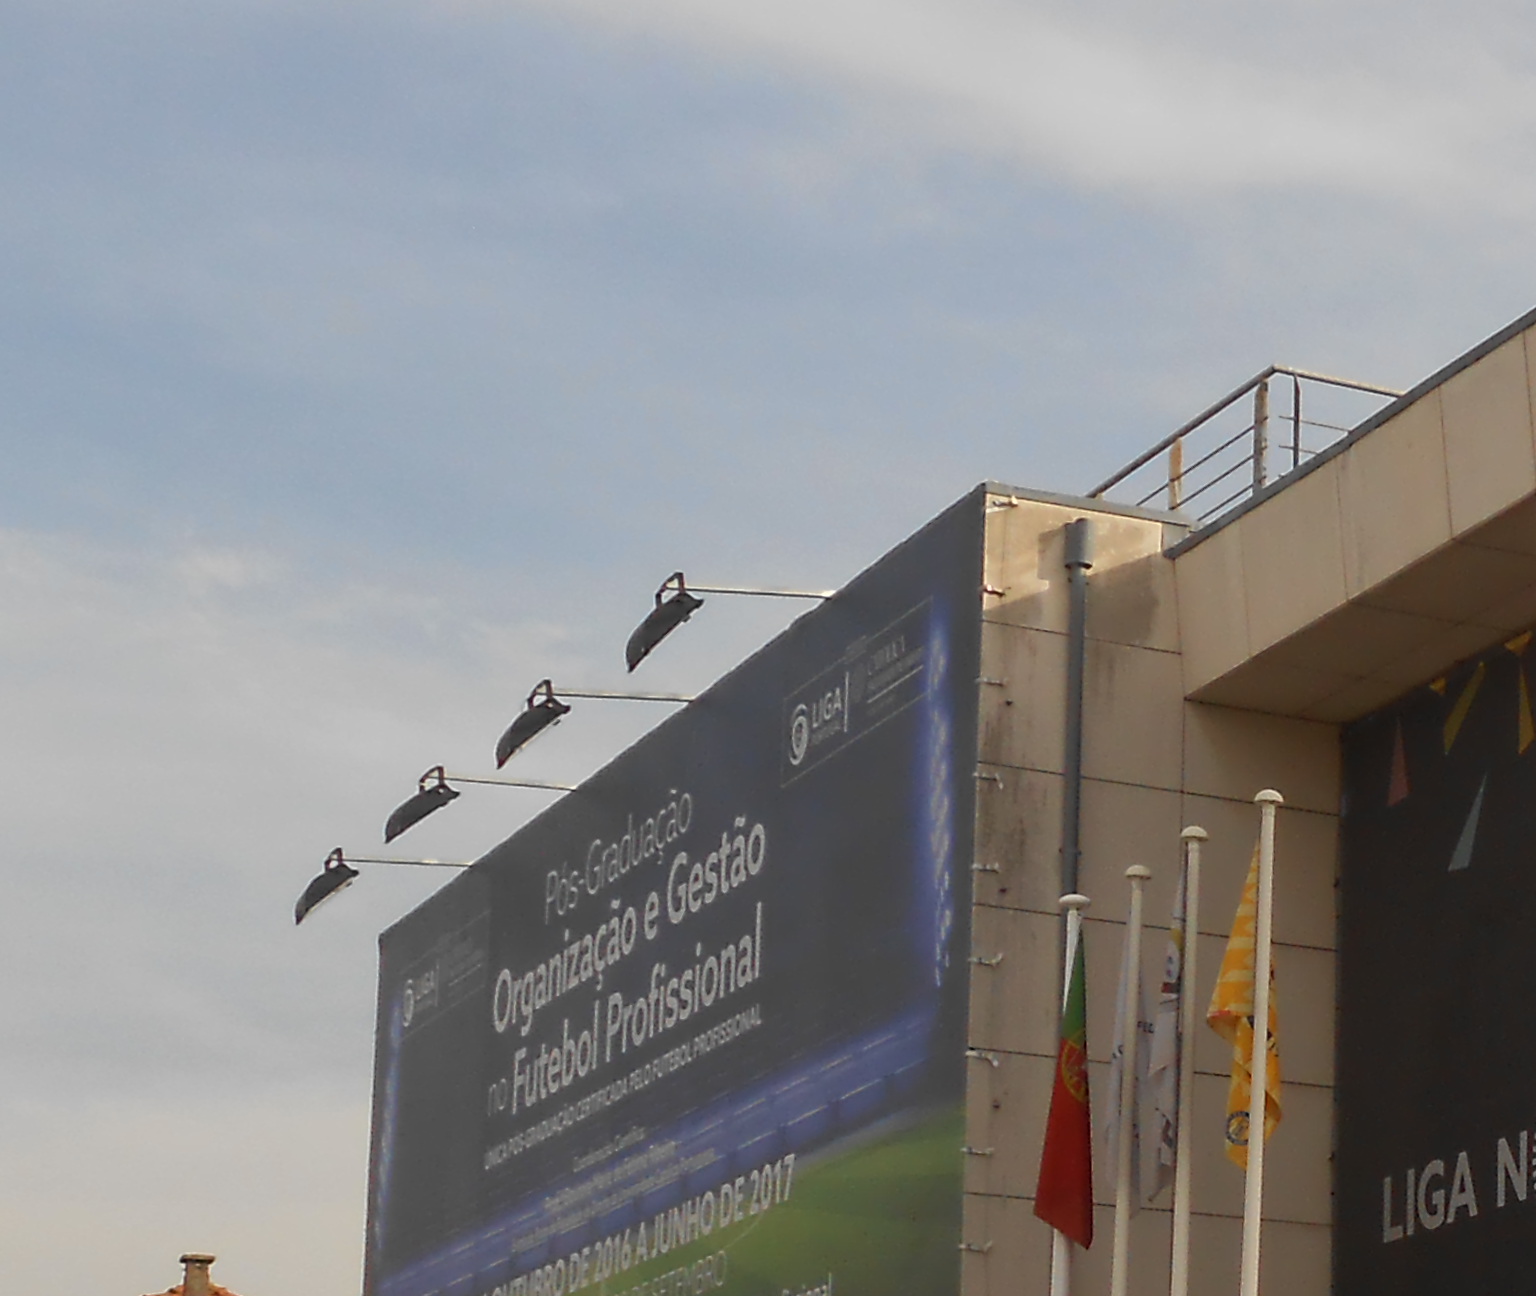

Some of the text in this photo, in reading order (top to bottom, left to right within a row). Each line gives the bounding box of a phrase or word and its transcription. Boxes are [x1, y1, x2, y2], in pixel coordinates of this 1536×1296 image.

[811, 686, 844, 730] LIGA
[494, 898, 638, 1037] Organização
[644, 891, 660, 941] e
[667, 815, 766, 924] Gestão
[546, 788, 693, 926] Pós-Graduação
[489, 1078, 509, 1117] no
[512, 1000, 600, 1115] Futebol
[606, 901, 764, 1063] Profissional
[569, 1247, 592, 1293] DE
[593, 1229, 633, 1283] 2016
[637, 1222, 652, 1265] A
[651, 1191, 717, 1259] JUNHO
[721, 1176, 748, 1229] DE
[750, 1153, 797, 1216] 2017
[1383, 1150, 1478, 1243] LIGA
